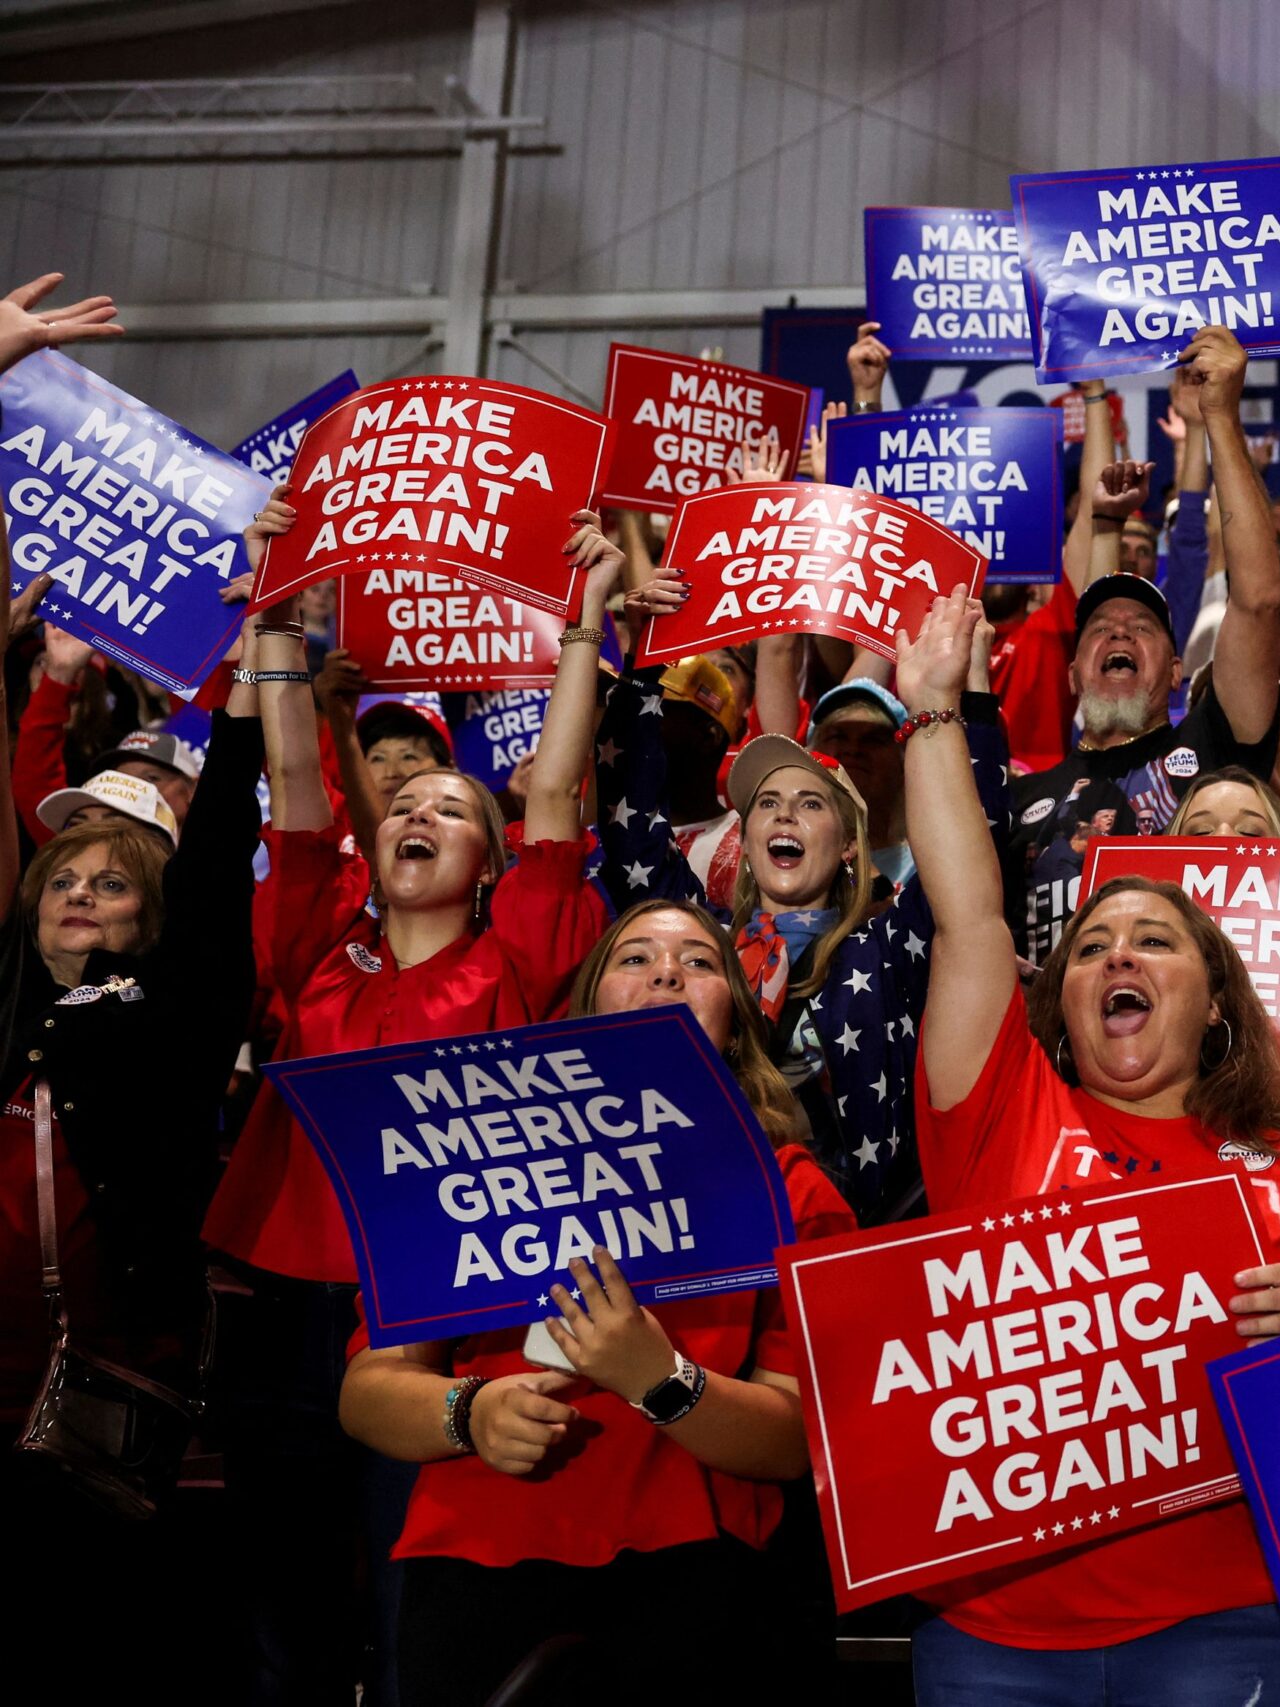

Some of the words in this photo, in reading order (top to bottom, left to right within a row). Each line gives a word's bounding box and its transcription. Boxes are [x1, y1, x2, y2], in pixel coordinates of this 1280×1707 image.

[1098, 180, 1242, 223] MAKE
[921, 224, 1018, 252] MAKE
[892, 254, 1021, 281] AMERIC
[1096, 253, 1263, 301] GREAT
[913, 283, 1025, 310] GREAT
[1098, 291, 1275, 347] AGAIN!
[910, 312, 1030, 339] AGAIN!
[350, 396, 516, 438] MAKE
[670, 371, 764, 417] MAKE
[75, 407, 233, 520] MAKE
[301, 432, 553, 492] AMERICA
[653, 433, 750, 474] GREA
[880, 427, 992, 460] MAKE
[0, 424, 238, 579] AMERICA
[322, 469, 515, 516] GREAT
[852, 461, 1028, 494] AMERICA
[9, 477, 191, 593] GREAT
[305, 507, 510, 562] AGAIN!
[751, 497, 908, 544] MAKE
[3, 512, 165, 635] GAIN!
[695, 525, 939, 593] AMERICA
[720, 555, 906, 600] GREAT
[387, 594, 524, 630] GREAT
[705, 584, 901, 637] AGAIN!
[385, 632, 534, 667] AGAIN!
[484, 704, 543, 742] GRE
[1168, 753, 1195, 763] TEAM
[393, 1048, 605, 1114] MAKE
[380, 1088, 695, 1175] AMERICA
[438, 1142, 663, 1223] GREAT
[453, 1197, 695, 1288] AGAIN!
[923, 1215, 1150, 1318] MAKE
[871, 1271, 1228, 1405] AMERICA
[929, 1344, 1187, 1458] GREAT
[934, 1408, 1201, 1533] AGAIN!
